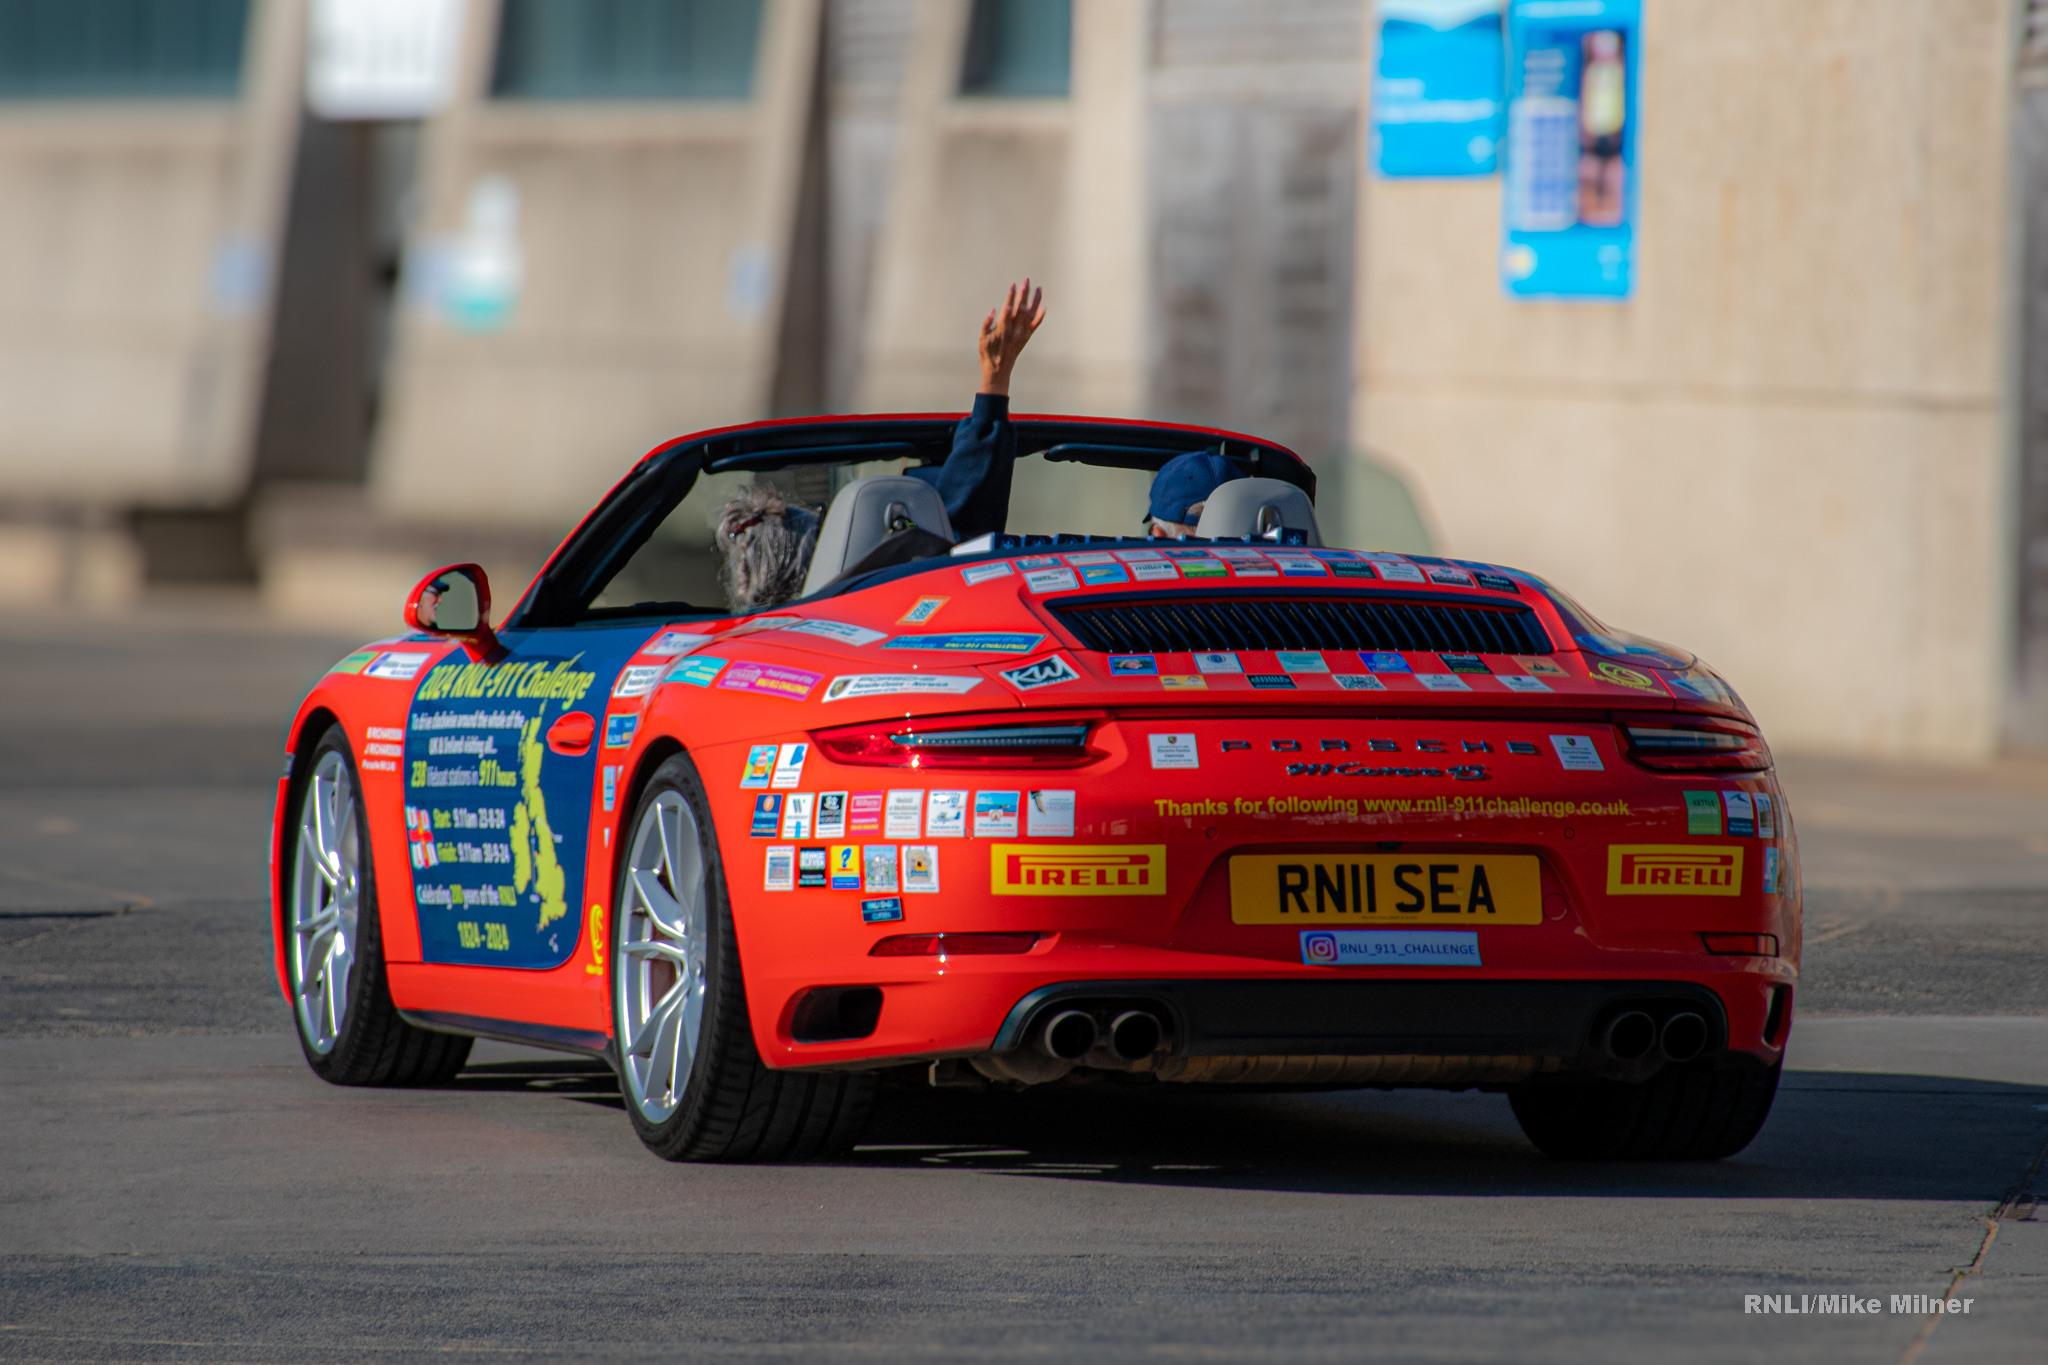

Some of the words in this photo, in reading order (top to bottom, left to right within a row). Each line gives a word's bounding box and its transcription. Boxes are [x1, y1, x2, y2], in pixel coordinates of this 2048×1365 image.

[417, 664, 464, 701] 2024
[516, 660, 597, 711] Challenge
[1222, 739, 1537, 754] PORSCHE
[479, 759, 498, 787] 911
[1154, 798, 1229, 817] Thanks
[1234, 797, 1263, 815] for
[1267, 795, 1359, 816] following
[1364, 795, 1630, 818] www.rnli-911challenge.co.uk
[1007, 854, 1150, 886] PIRELLI
[1620, 854, 1734, 886] PIRELLI
[1393, 864, 1497, 914] SEA
[1340, 943, 1477, 957] RNLI_911_CHALLENGE
